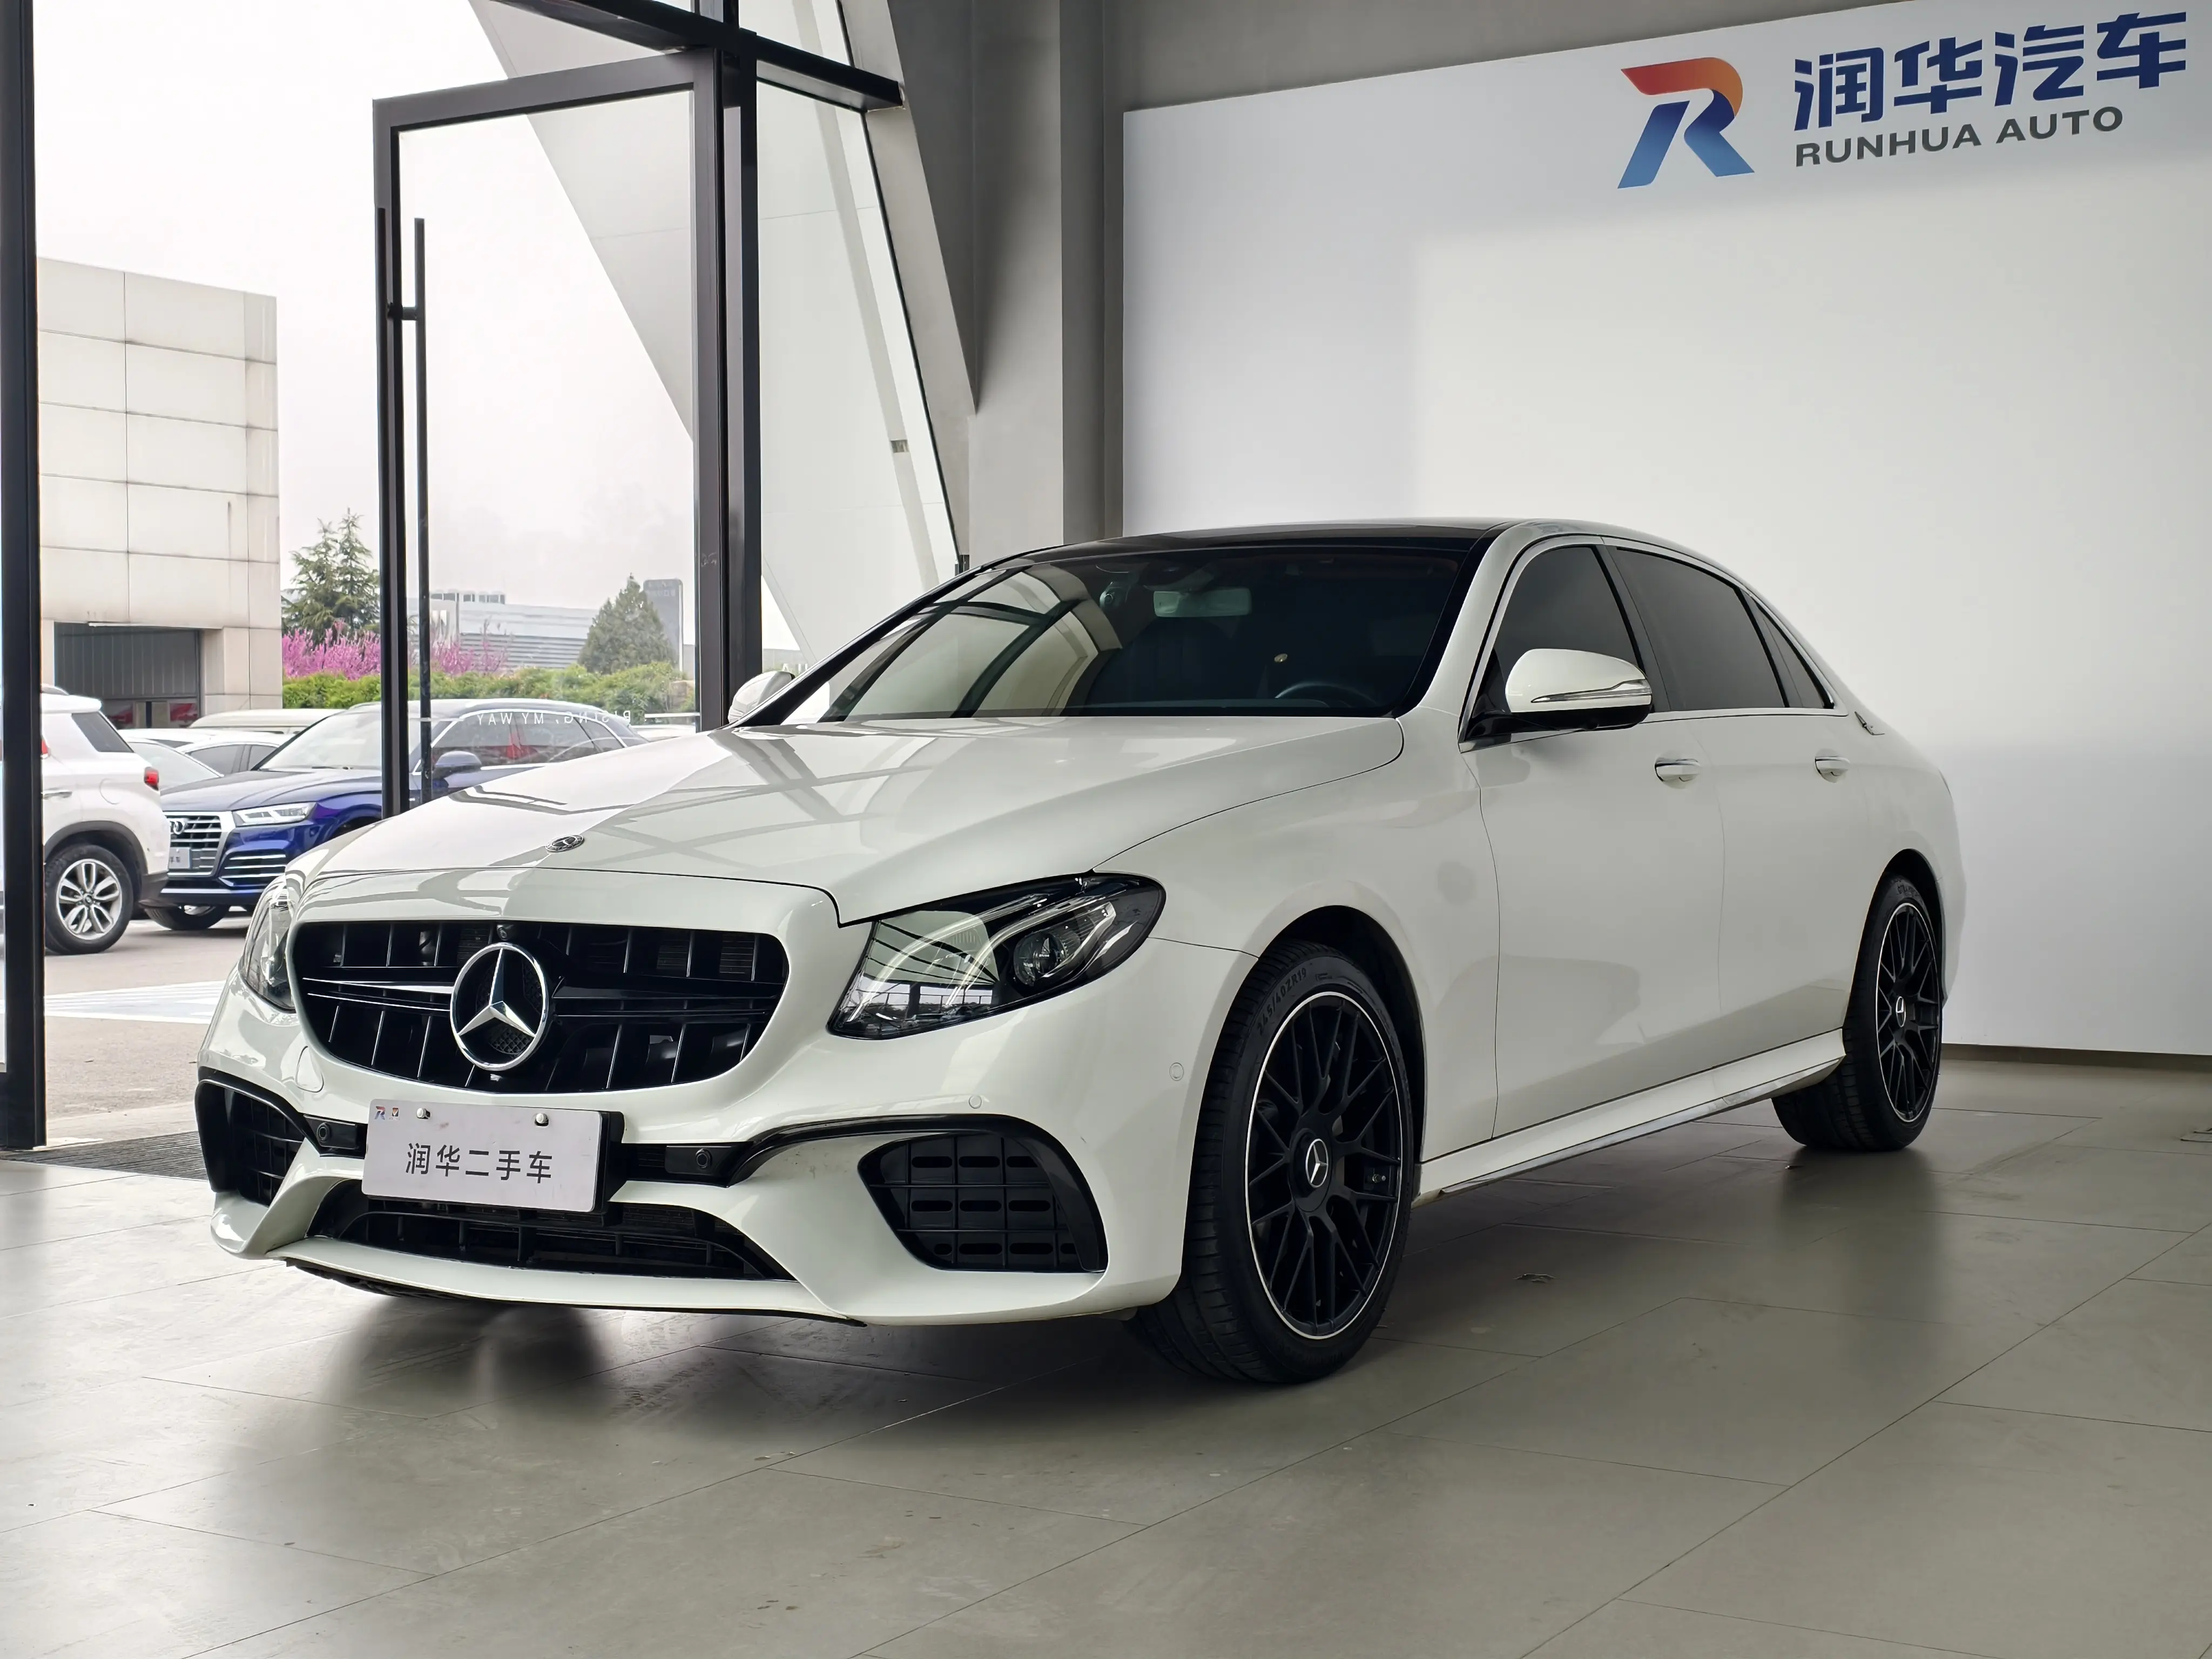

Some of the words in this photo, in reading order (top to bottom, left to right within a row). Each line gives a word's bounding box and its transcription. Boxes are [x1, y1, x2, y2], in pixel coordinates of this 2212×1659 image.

[1794, 12, 2187, 131] 润华汽车
[1796, 124, 1982, 167] RUNHUA
[1995, 106, 2124, 143] AUTO
[405, 1143, 552, 1184] 润华二手车
